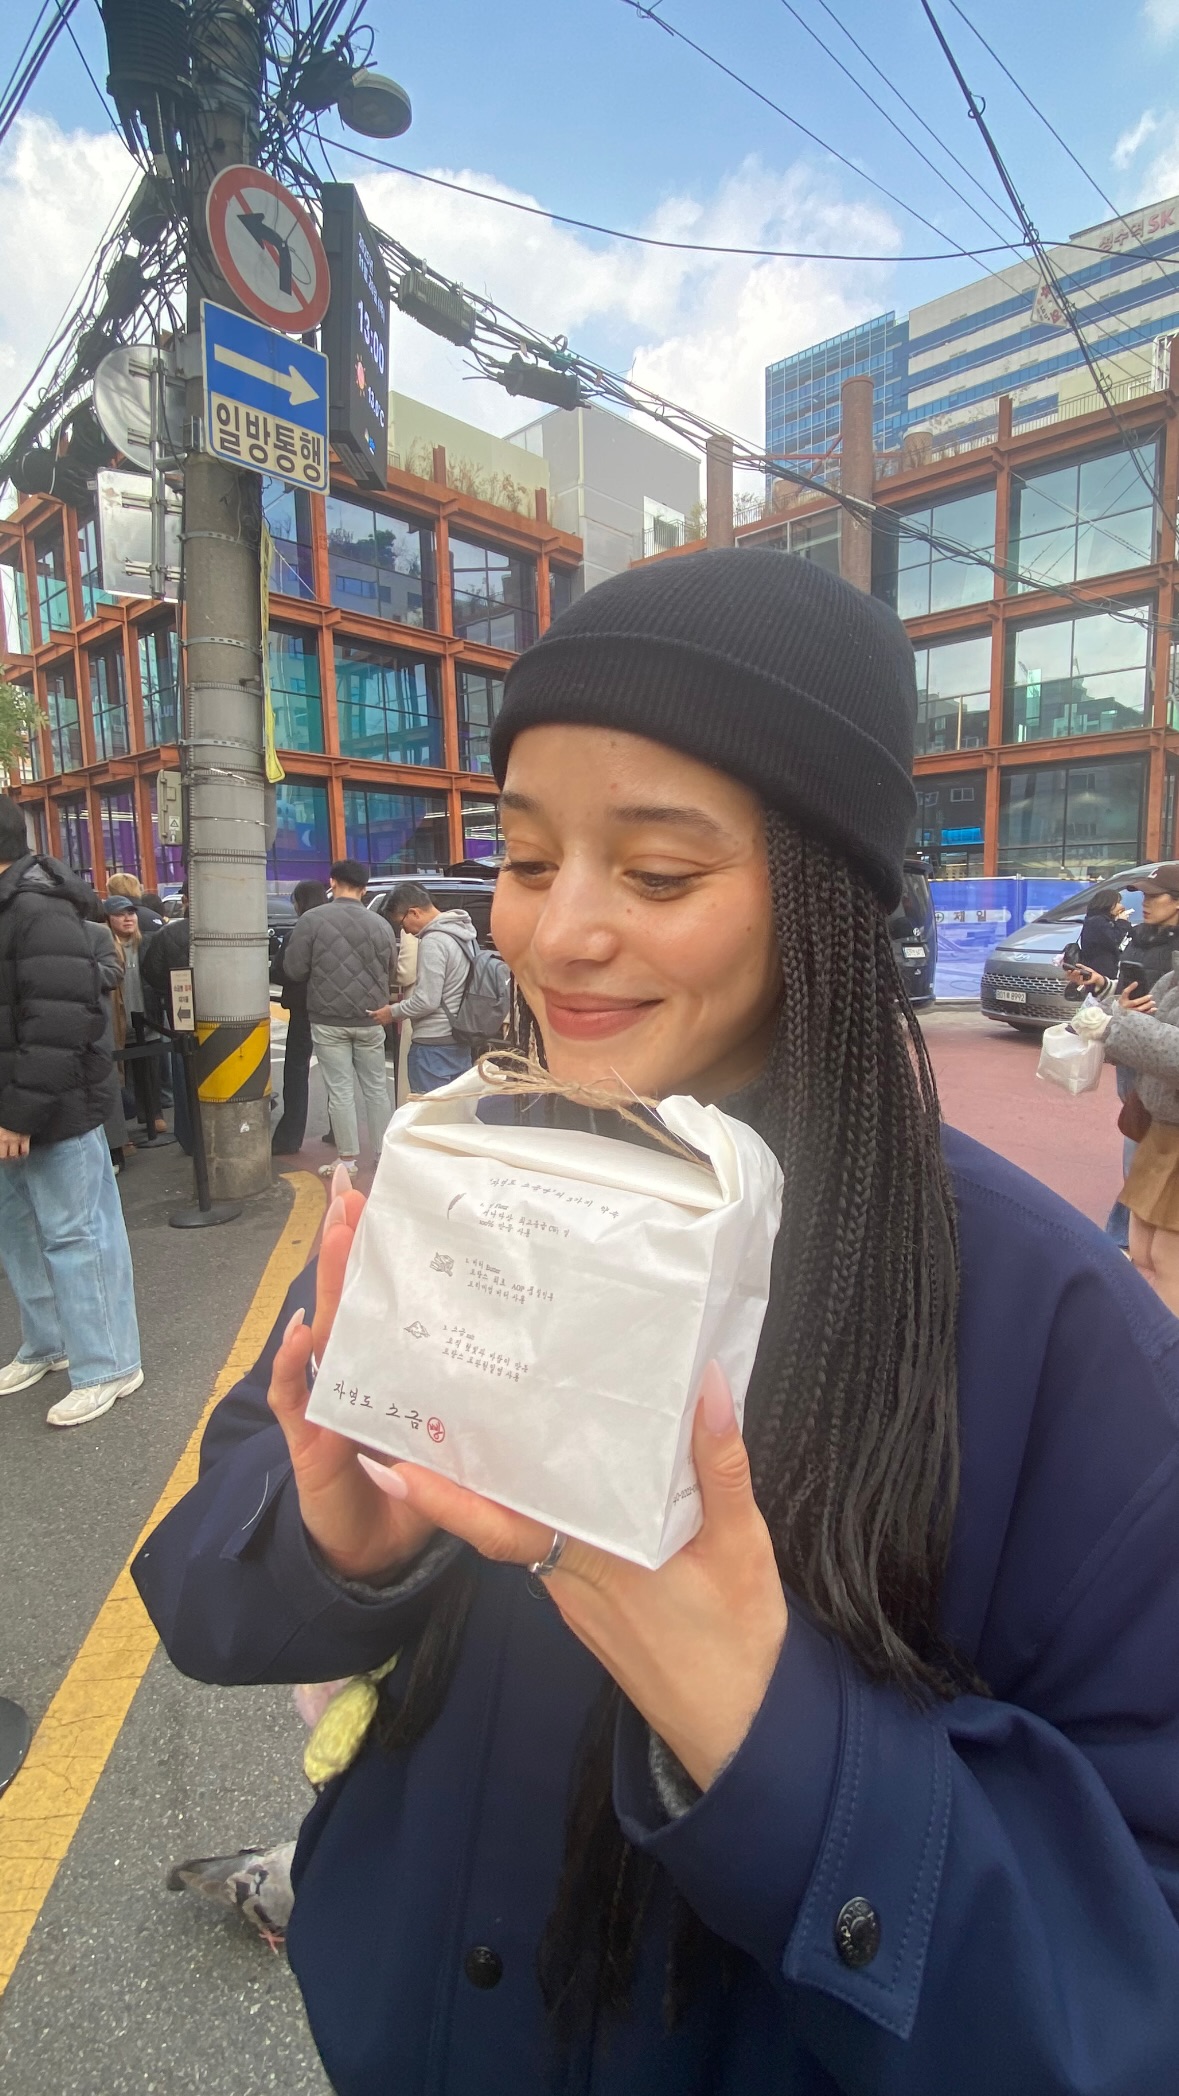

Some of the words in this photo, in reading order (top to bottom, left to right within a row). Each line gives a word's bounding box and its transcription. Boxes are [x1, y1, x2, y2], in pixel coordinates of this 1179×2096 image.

[1147, 207, 1175, 235] SK
[358, 300, 385, 375] 13:00
[216, 402, 322, 483] 일방통행
